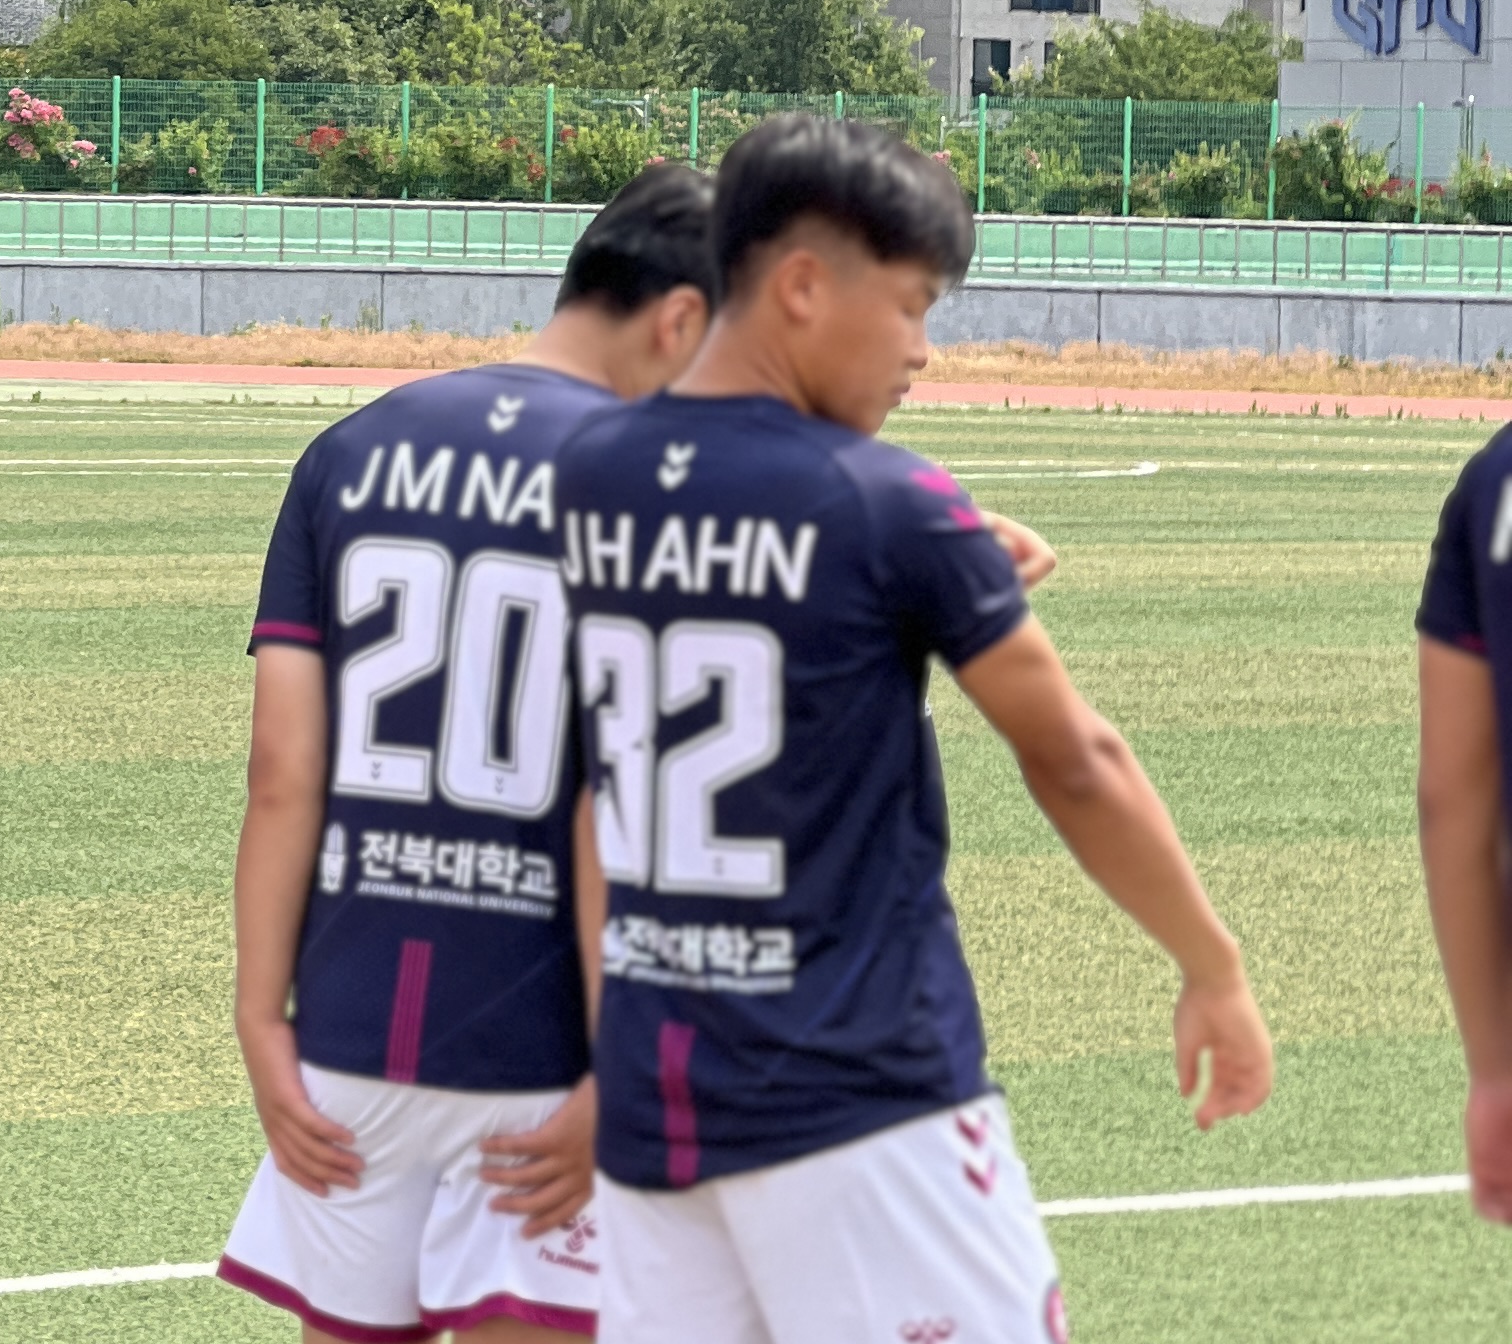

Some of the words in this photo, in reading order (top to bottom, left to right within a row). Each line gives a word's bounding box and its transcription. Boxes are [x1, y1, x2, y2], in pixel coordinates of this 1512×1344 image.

[641, 515, 818, 601] AHN
[333, 533, 571, 820] 20
[577, 612, 785, 899] 32
[357, 882, 414, 898] JEONBUK
[416, 888, 475, 905] NATIONAL
[479, 895, 554, 918] UNIVERSITY
[360, 832, 558, 897] 전북대학교
[622, 916, 797, 979] 전대학교
